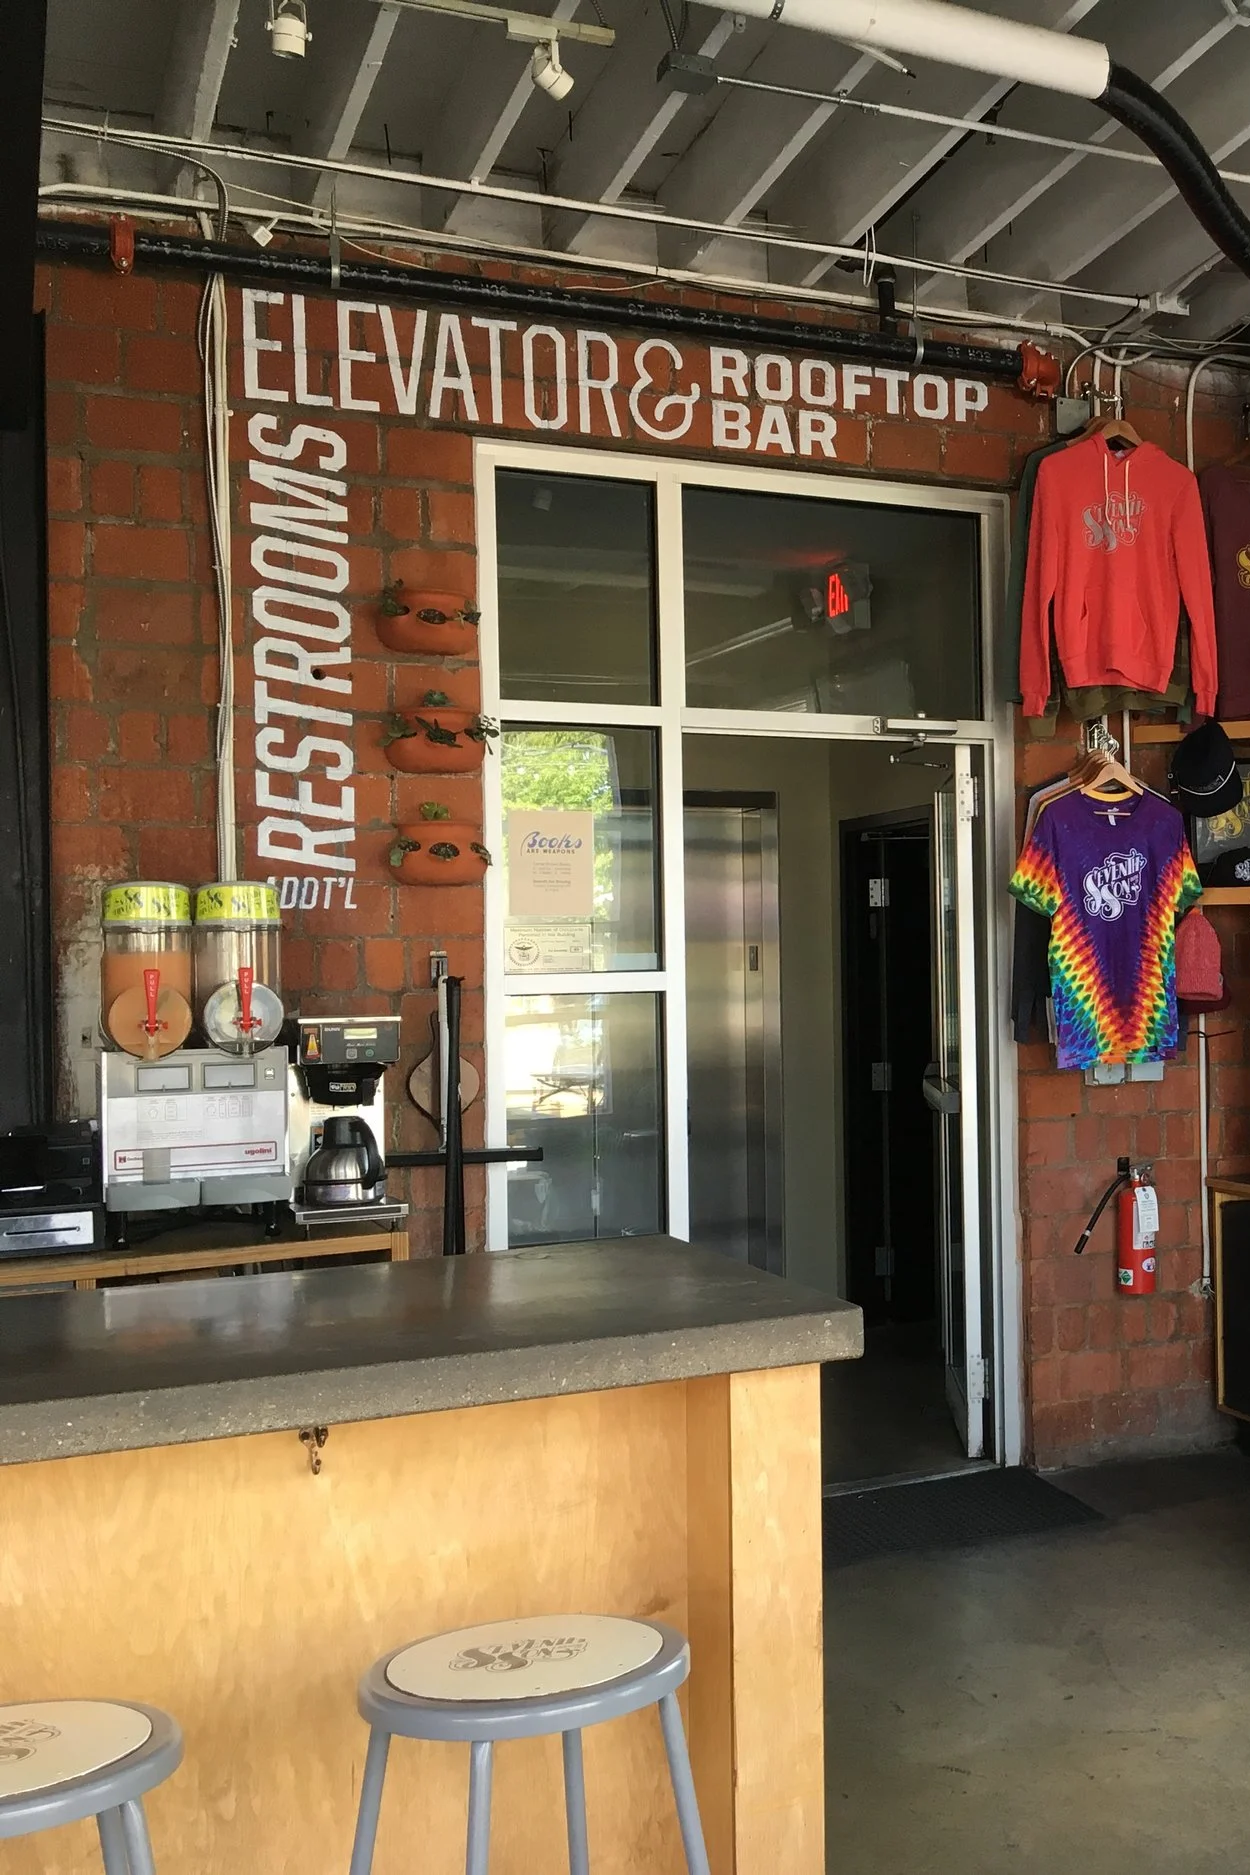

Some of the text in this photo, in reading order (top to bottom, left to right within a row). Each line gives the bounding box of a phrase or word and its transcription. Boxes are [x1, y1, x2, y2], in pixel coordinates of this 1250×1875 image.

[243, 289, 989, 441] ELEVATOR & ROOFTOP
[712, 401, 839, 459] BAR
[245, 412, 357, 872] RESTROOMS
[520, 831, 583, 855] Books
[1084, 848, 1146, 914] SEVENTH
[1101, 880, 1140, 919] SON
